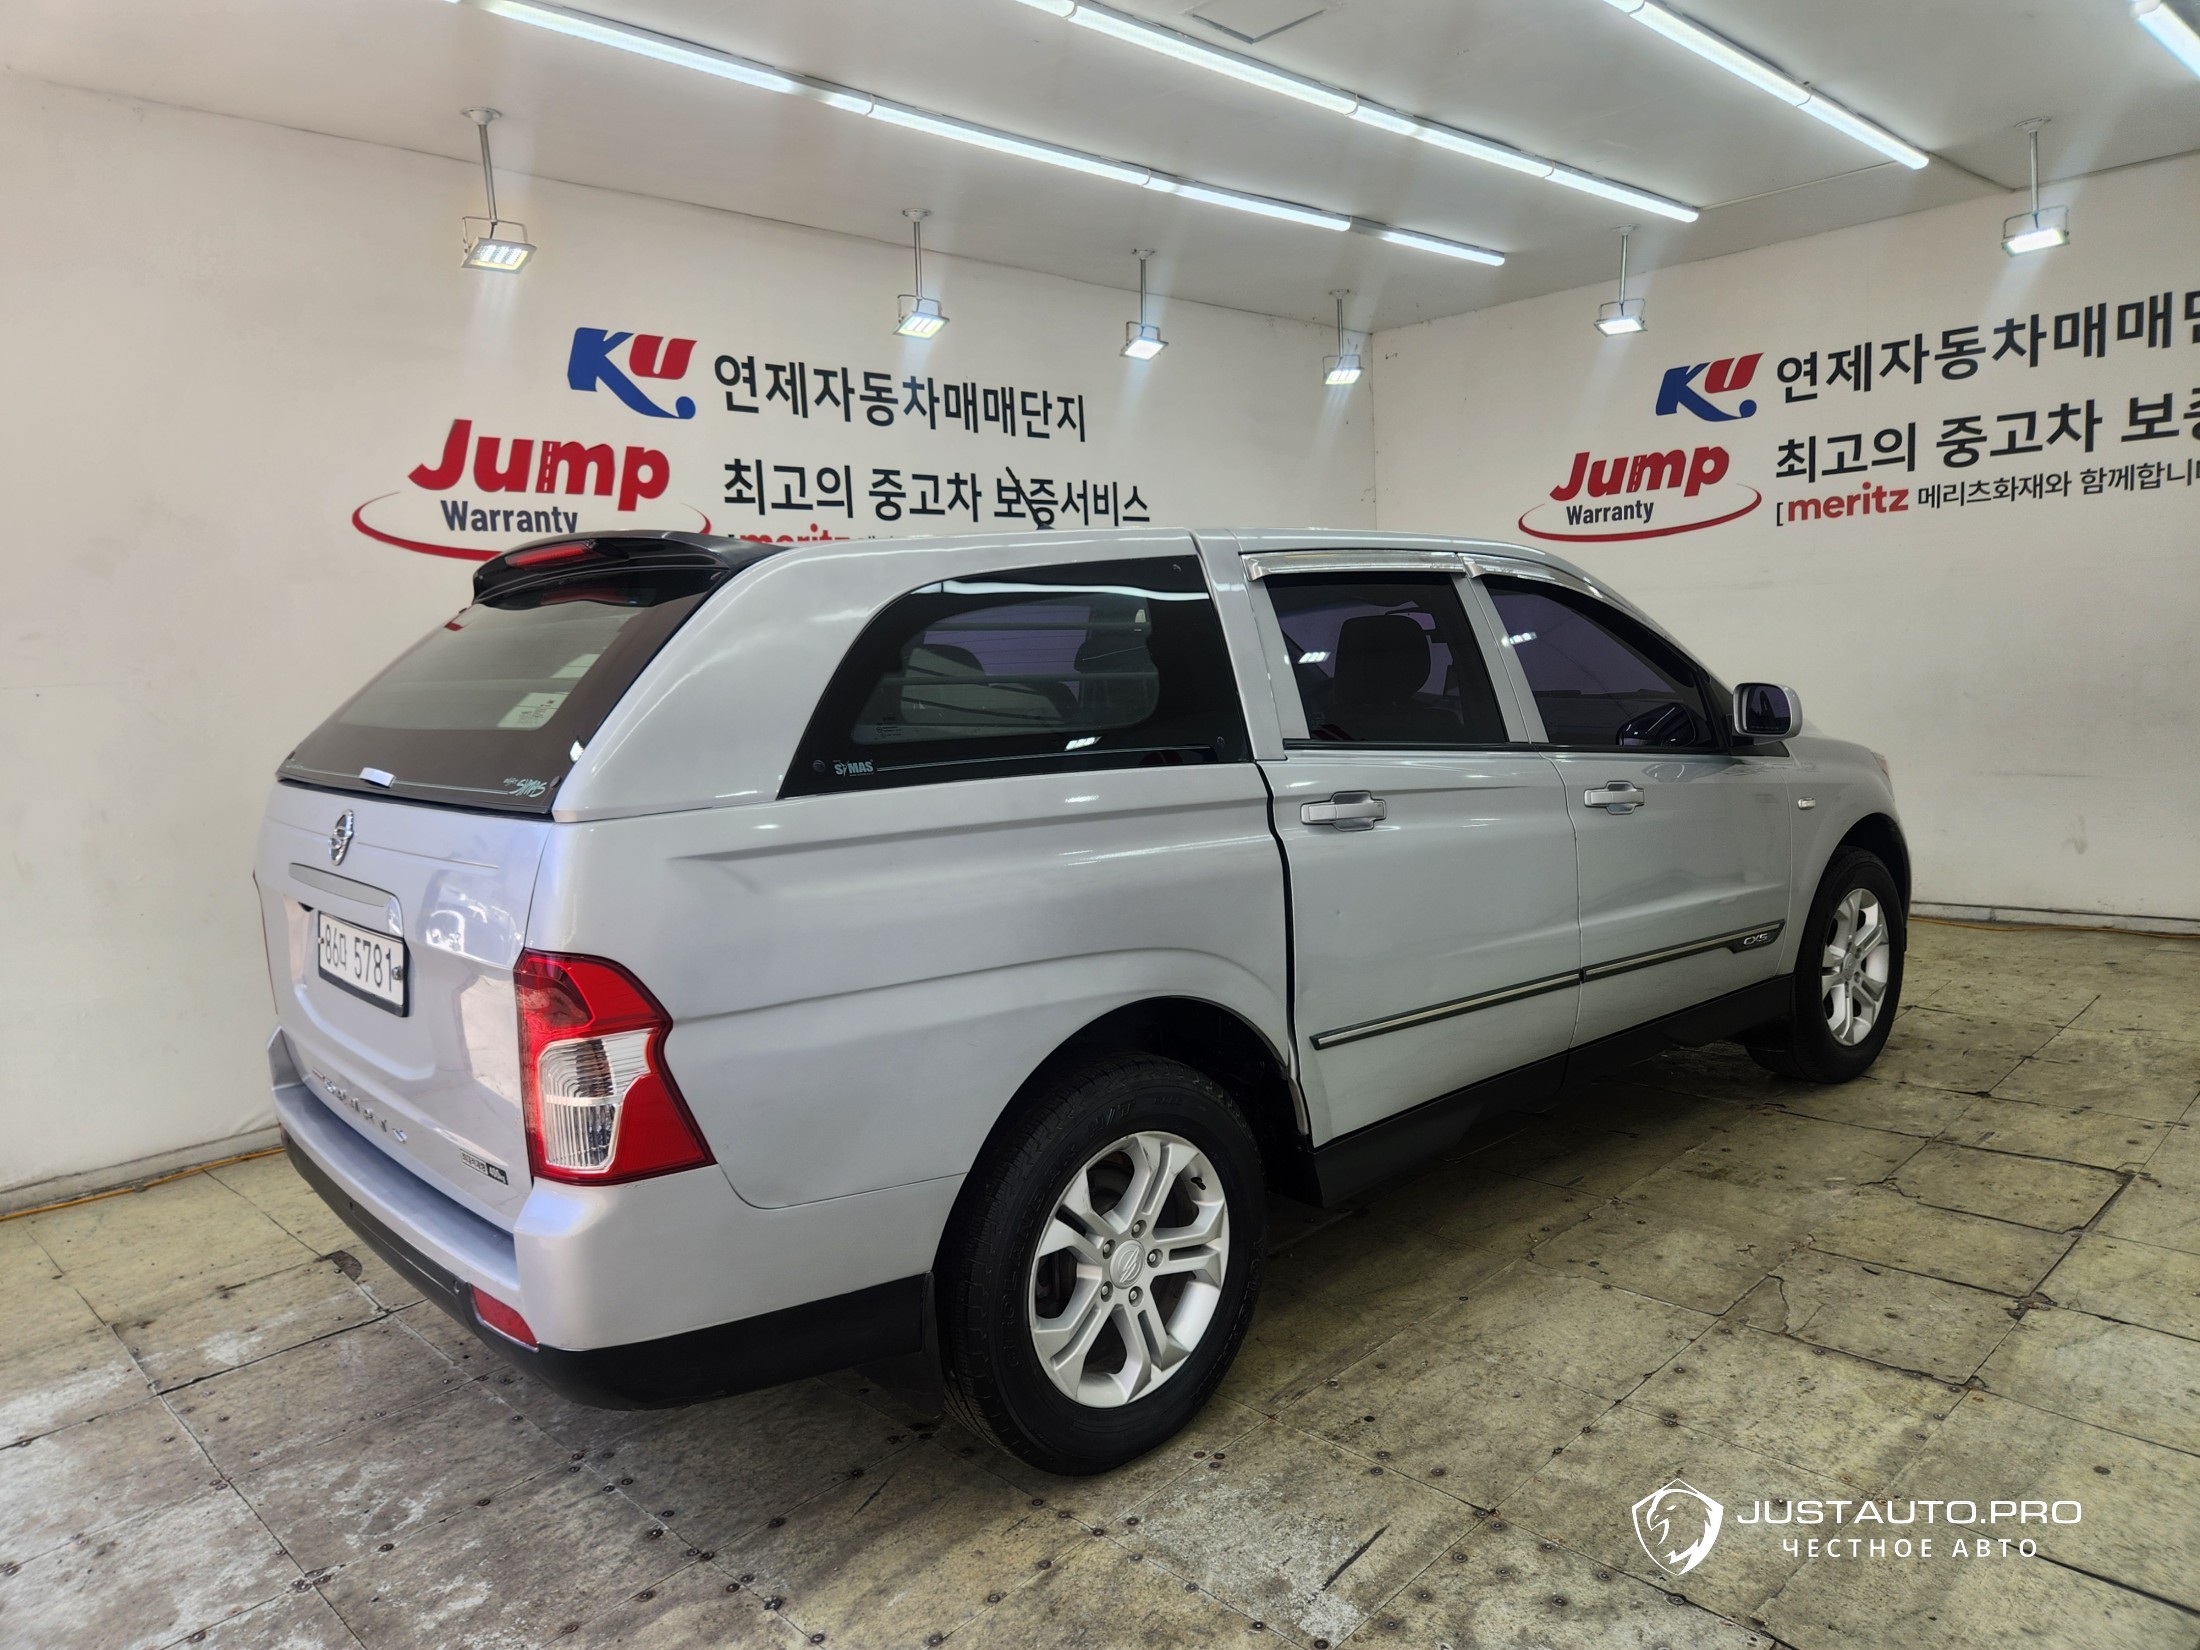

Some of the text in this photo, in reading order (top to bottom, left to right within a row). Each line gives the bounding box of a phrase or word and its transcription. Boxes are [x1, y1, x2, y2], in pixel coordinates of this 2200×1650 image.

[714, 354, 1086, 442] 연제자동차매매단지
[408, 419, 670, 511] Jump
[1776, 422, 1916, 483] 최고의
[1936, 399, 2103, 468] 중고차
[724, 459, 1150, 527] 최고의 중고차 보증서비스
[1550, 446, 1729, 501] Jump
[1918, 471, 2072, 509] 메리츠화재와
[2080, 458, 2200, 495] 함께합니
[441, 500, 579, 534] Warranty
[1566, 499, 1655, 525] Warranty
[354, 936, 392, 993] 5781
